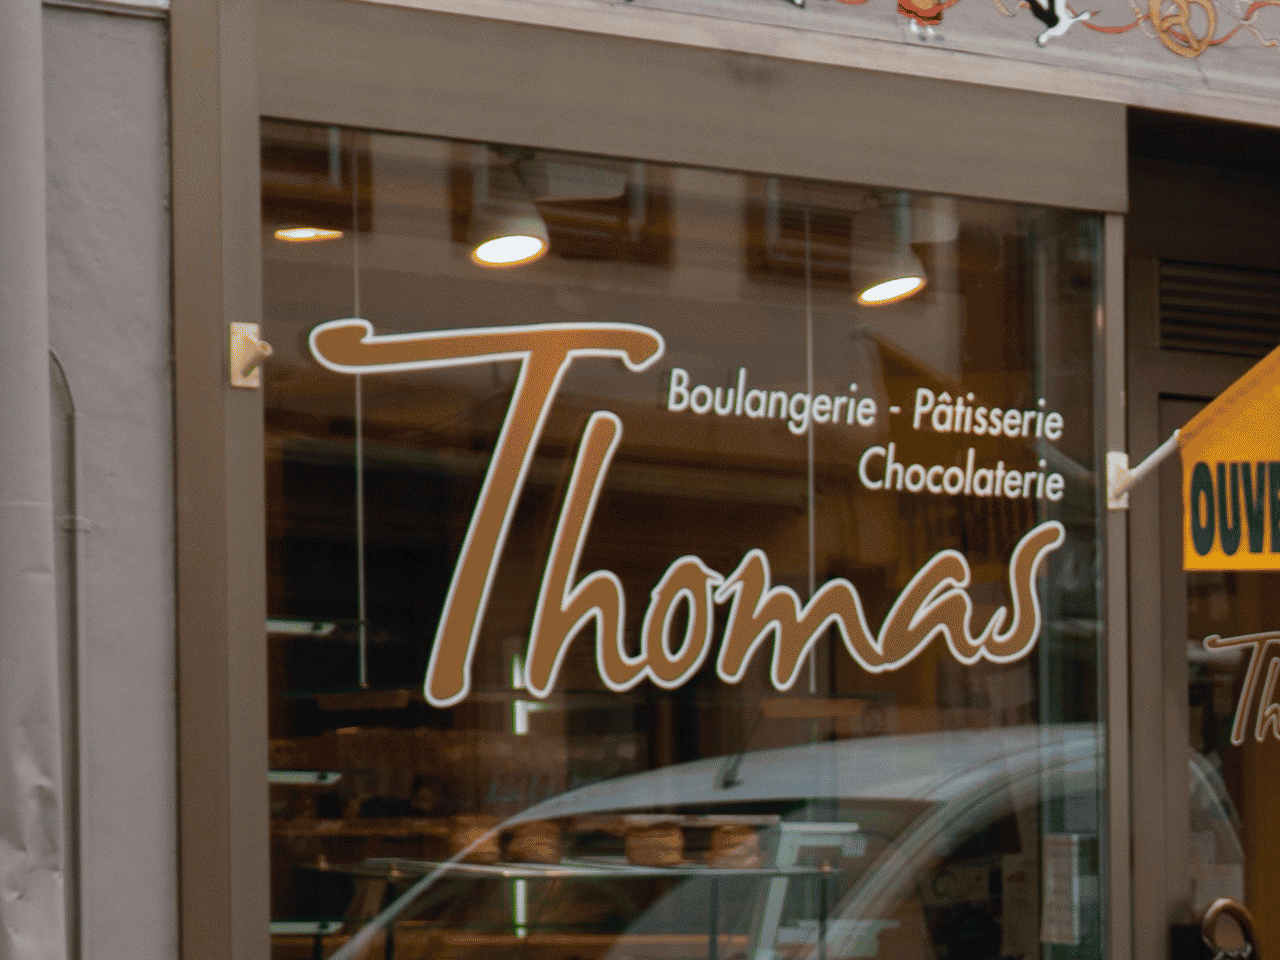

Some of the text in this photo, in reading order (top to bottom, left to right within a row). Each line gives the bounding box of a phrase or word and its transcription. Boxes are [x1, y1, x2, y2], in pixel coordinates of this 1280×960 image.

[668, 368, 877, 433] Boulangerie
[914, 388, 1065, 440] Pâtisserie
[858, 445, 1065, 501] Chocolaterie
[310, 318, 1065, 708] Thomas
